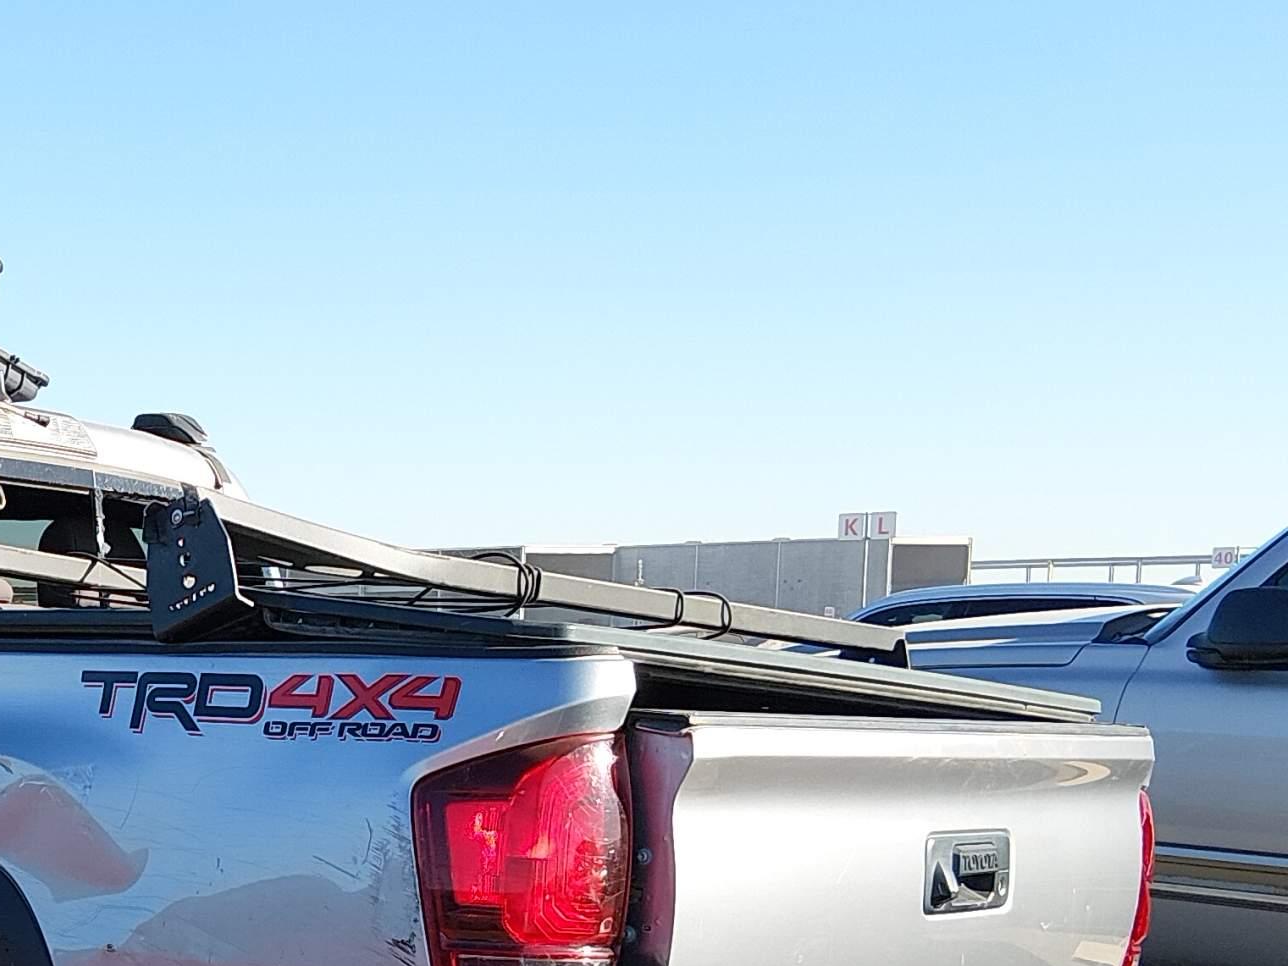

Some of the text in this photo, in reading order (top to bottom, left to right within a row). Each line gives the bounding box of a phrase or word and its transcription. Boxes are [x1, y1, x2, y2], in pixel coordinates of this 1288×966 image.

[844, 517, 859, 537] K
[877, 516, 890, 535] L
[1214, 551, 1233, 565] 40
[81, 670, 463, 736] TRD 4X4
[262, 720, 441, 743] OFF ROAD
